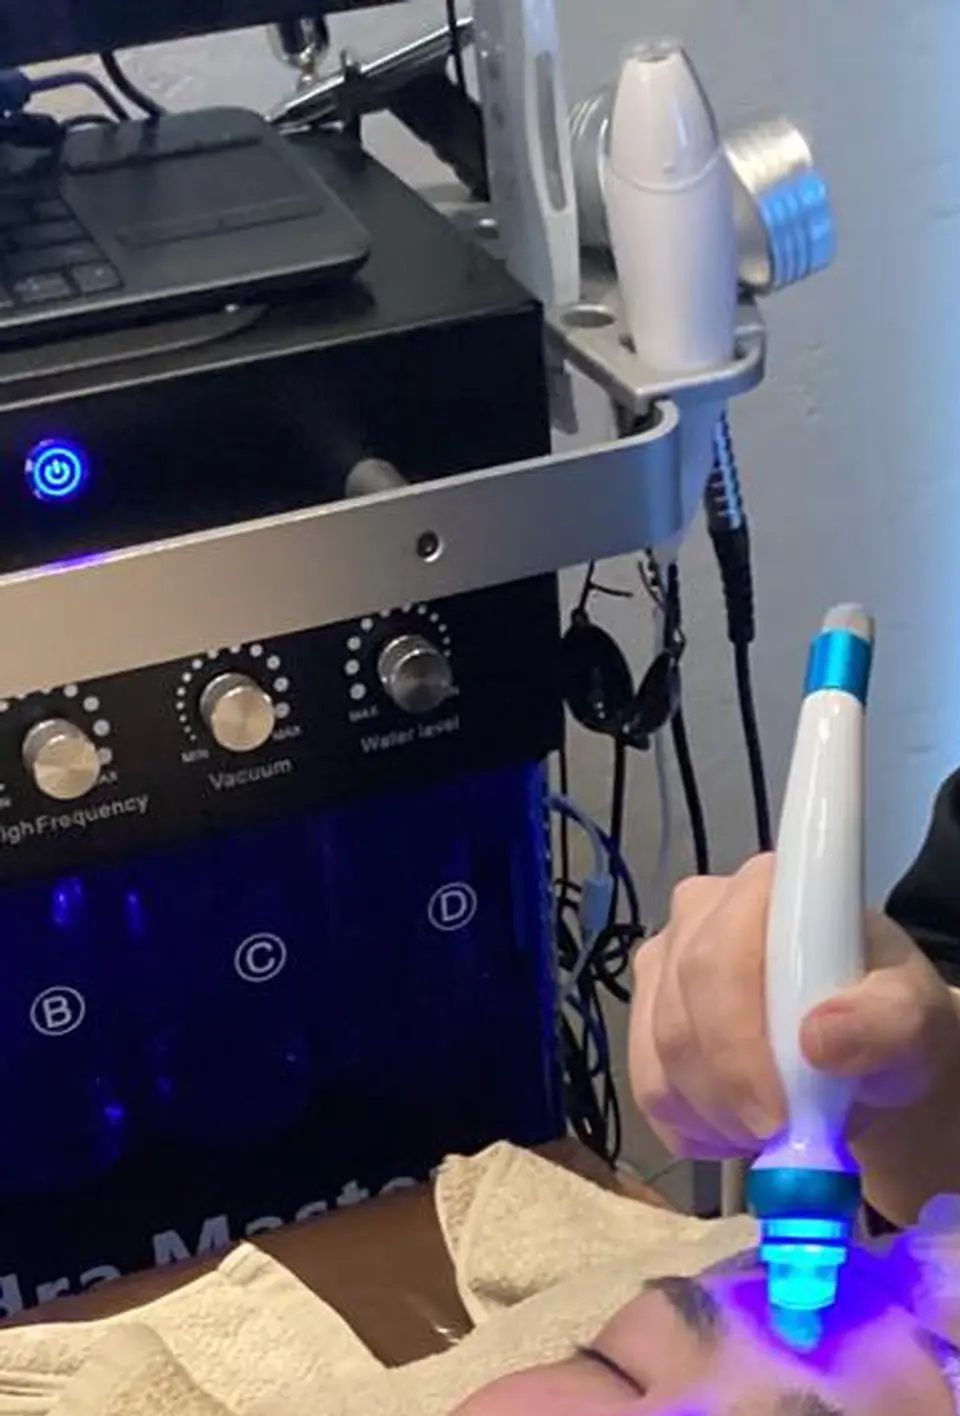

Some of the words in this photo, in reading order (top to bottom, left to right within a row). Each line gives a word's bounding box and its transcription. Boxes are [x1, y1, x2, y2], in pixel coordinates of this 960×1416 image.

[360, 728, 415, 753] Water
[418, 713, 460, 738] level
[208, 758, 293, 791] Vacuum
[0, 794, 149, 845] ighFrequency
